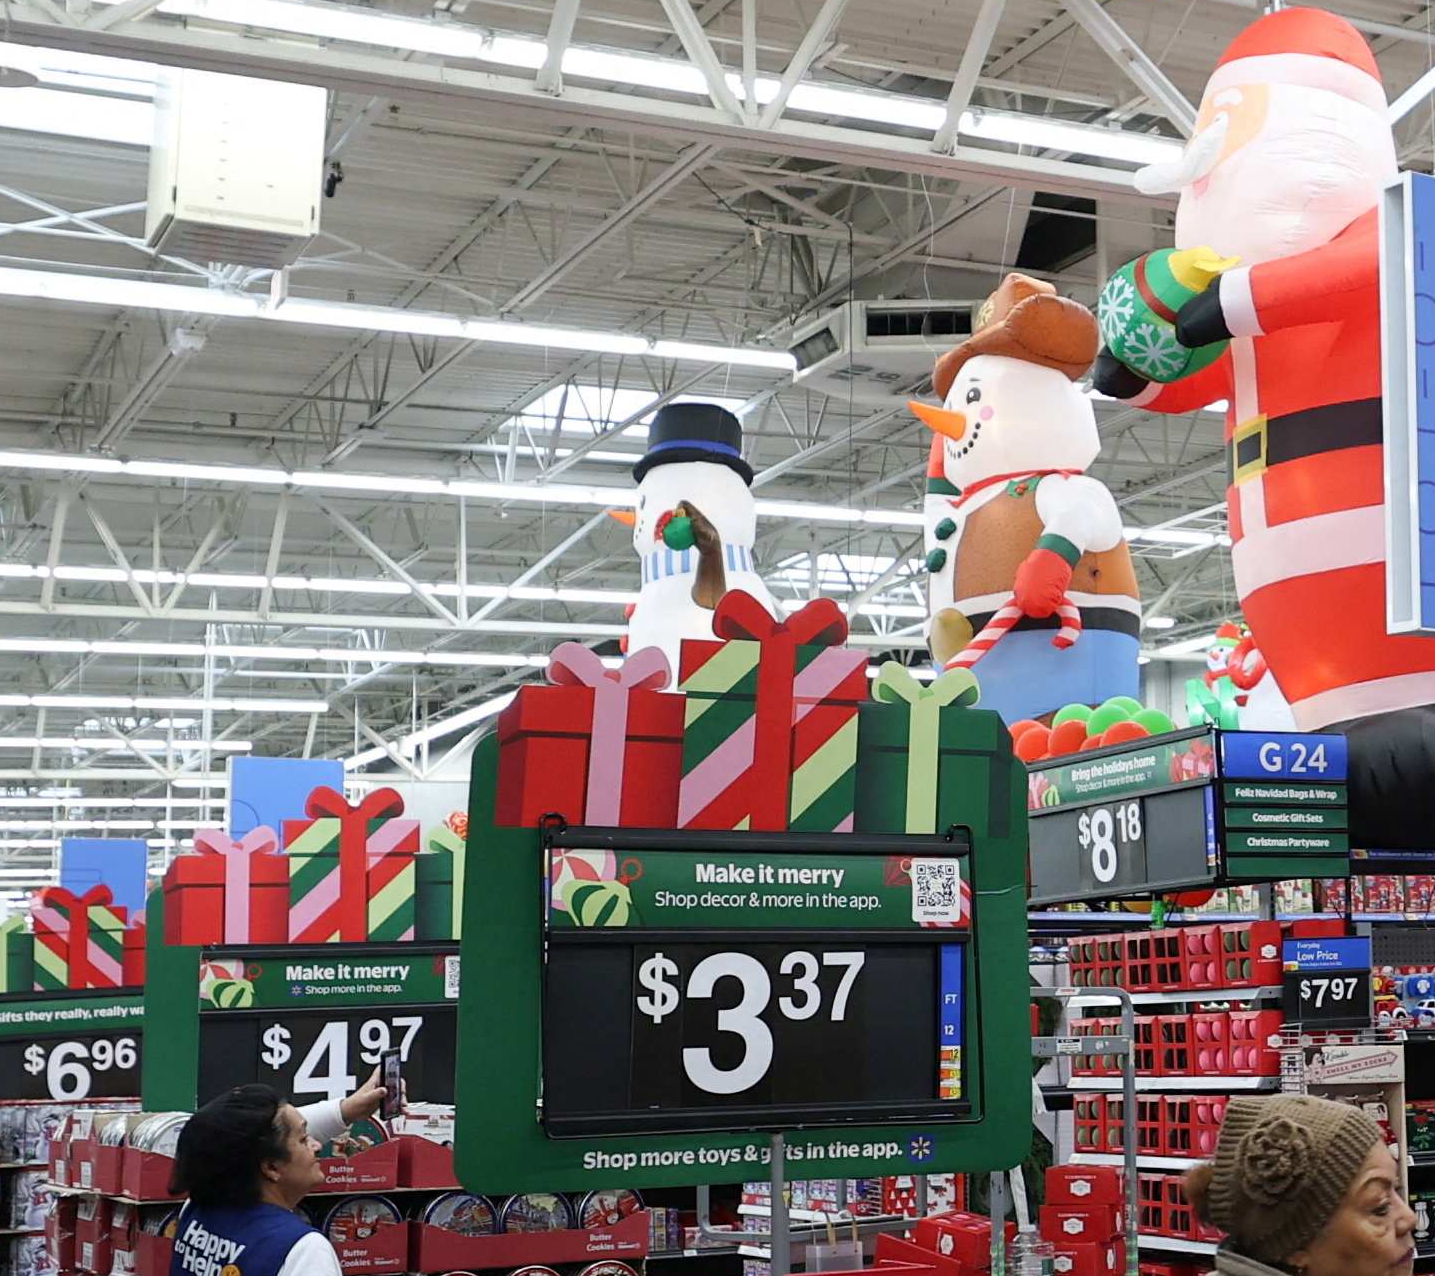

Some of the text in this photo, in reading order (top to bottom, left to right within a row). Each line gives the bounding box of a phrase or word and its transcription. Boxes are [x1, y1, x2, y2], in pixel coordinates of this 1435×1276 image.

[1259, 741, 1328, 774] G 24
[1071, 754, 1156, 782] Bring the holidays home
[1235, 788, 1254, 798] Feliz
[1255, 788, 1289, 799] Navidad
[1289, 788, 1308, 801] Bags
[1315, 789, 1338, 802] Wrap
[1252, 812, 1324, 824] Cosmetic Gift Sets
[1247, 837, 1331, 850] Christmas Partyware
[695, 862, 845, 888] Make it merry
[654, 890, 883, 911] Shop decor & more in the app.
[1296, 950, 1339, 962] Low Price
[285, 963, 410, 982] Make it merry
[304, 983, 403, 997] Shop more in the app.
[944, 993, 958, 1005] FT
[24, 1009, 53, 1024] they
[93, 1005, 131, 1020] really
[943, 1024, 955, 1036] 12
[583, 1150, 638, 1172] Shop
[640, 1149, 696, 1166] more
[698, 1145, 742, 1166] toys
[743, 1144, 758, 1161] &
[807, 1140, 826, 1160] in
[827, 1140, 861, 1159] the
[862, 1142, 903, 1162] app.
[182, 1219, 247, 1265] Happy
[589, 1232, 613, 1243] Butter
[173, 1238, 186, 1255] to
[342, 1248, 369, 1258] Butter
[586, 1242, 615, 1252] Cookies
[340, 1258, 372, 1269] Cookies
